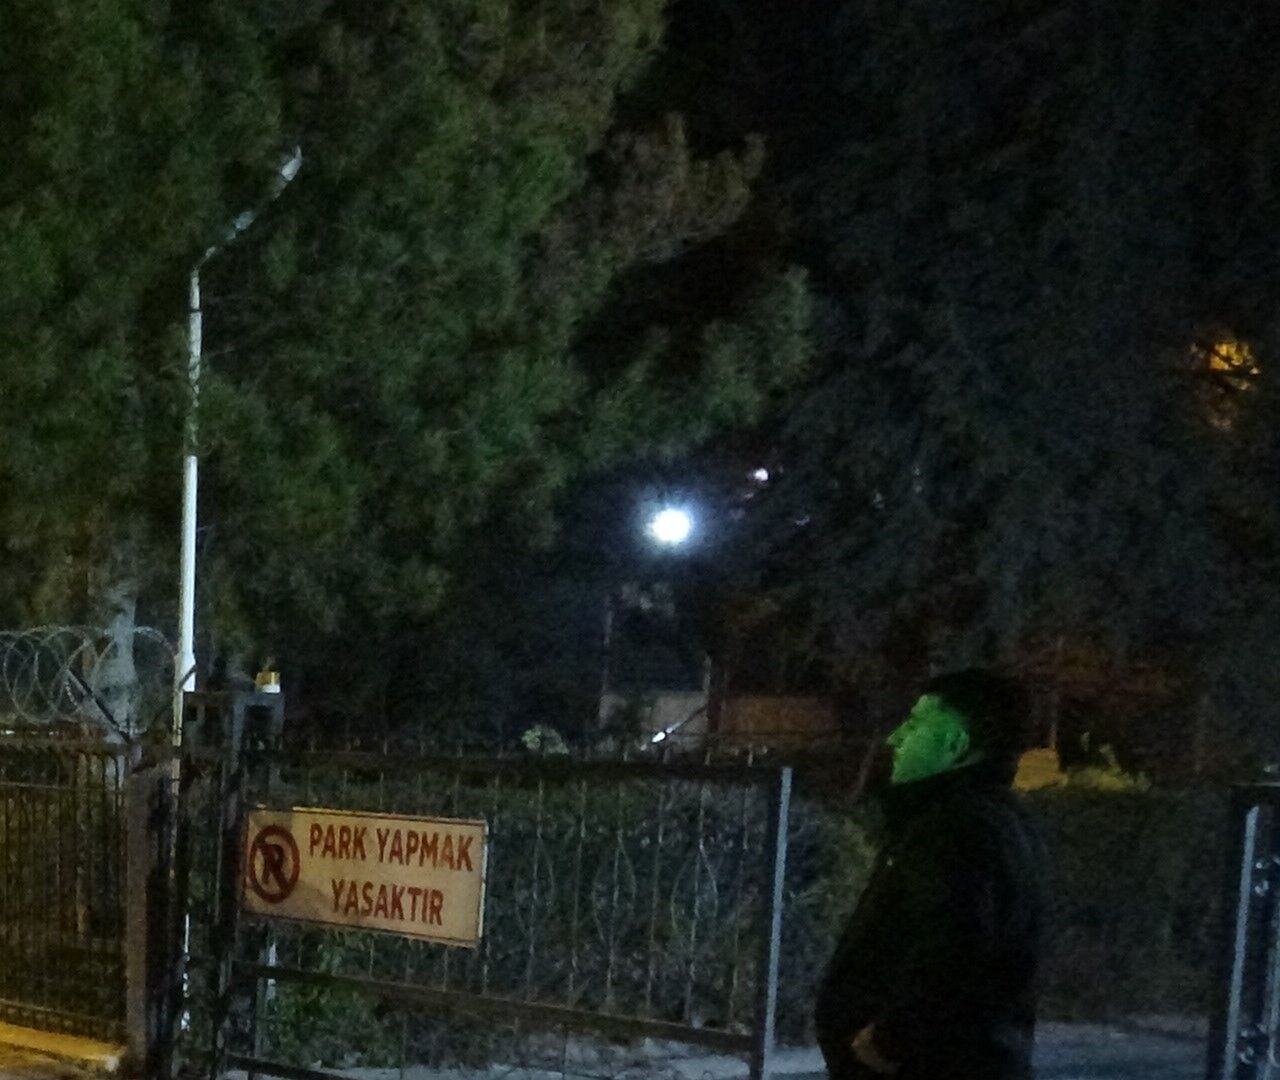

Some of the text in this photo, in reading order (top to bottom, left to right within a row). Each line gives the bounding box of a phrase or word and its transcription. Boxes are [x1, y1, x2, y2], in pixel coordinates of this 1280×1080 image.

[309, 823, 474, 872] PARK YAPMAK
[331, 878, 445, 926] YASAKTIR
